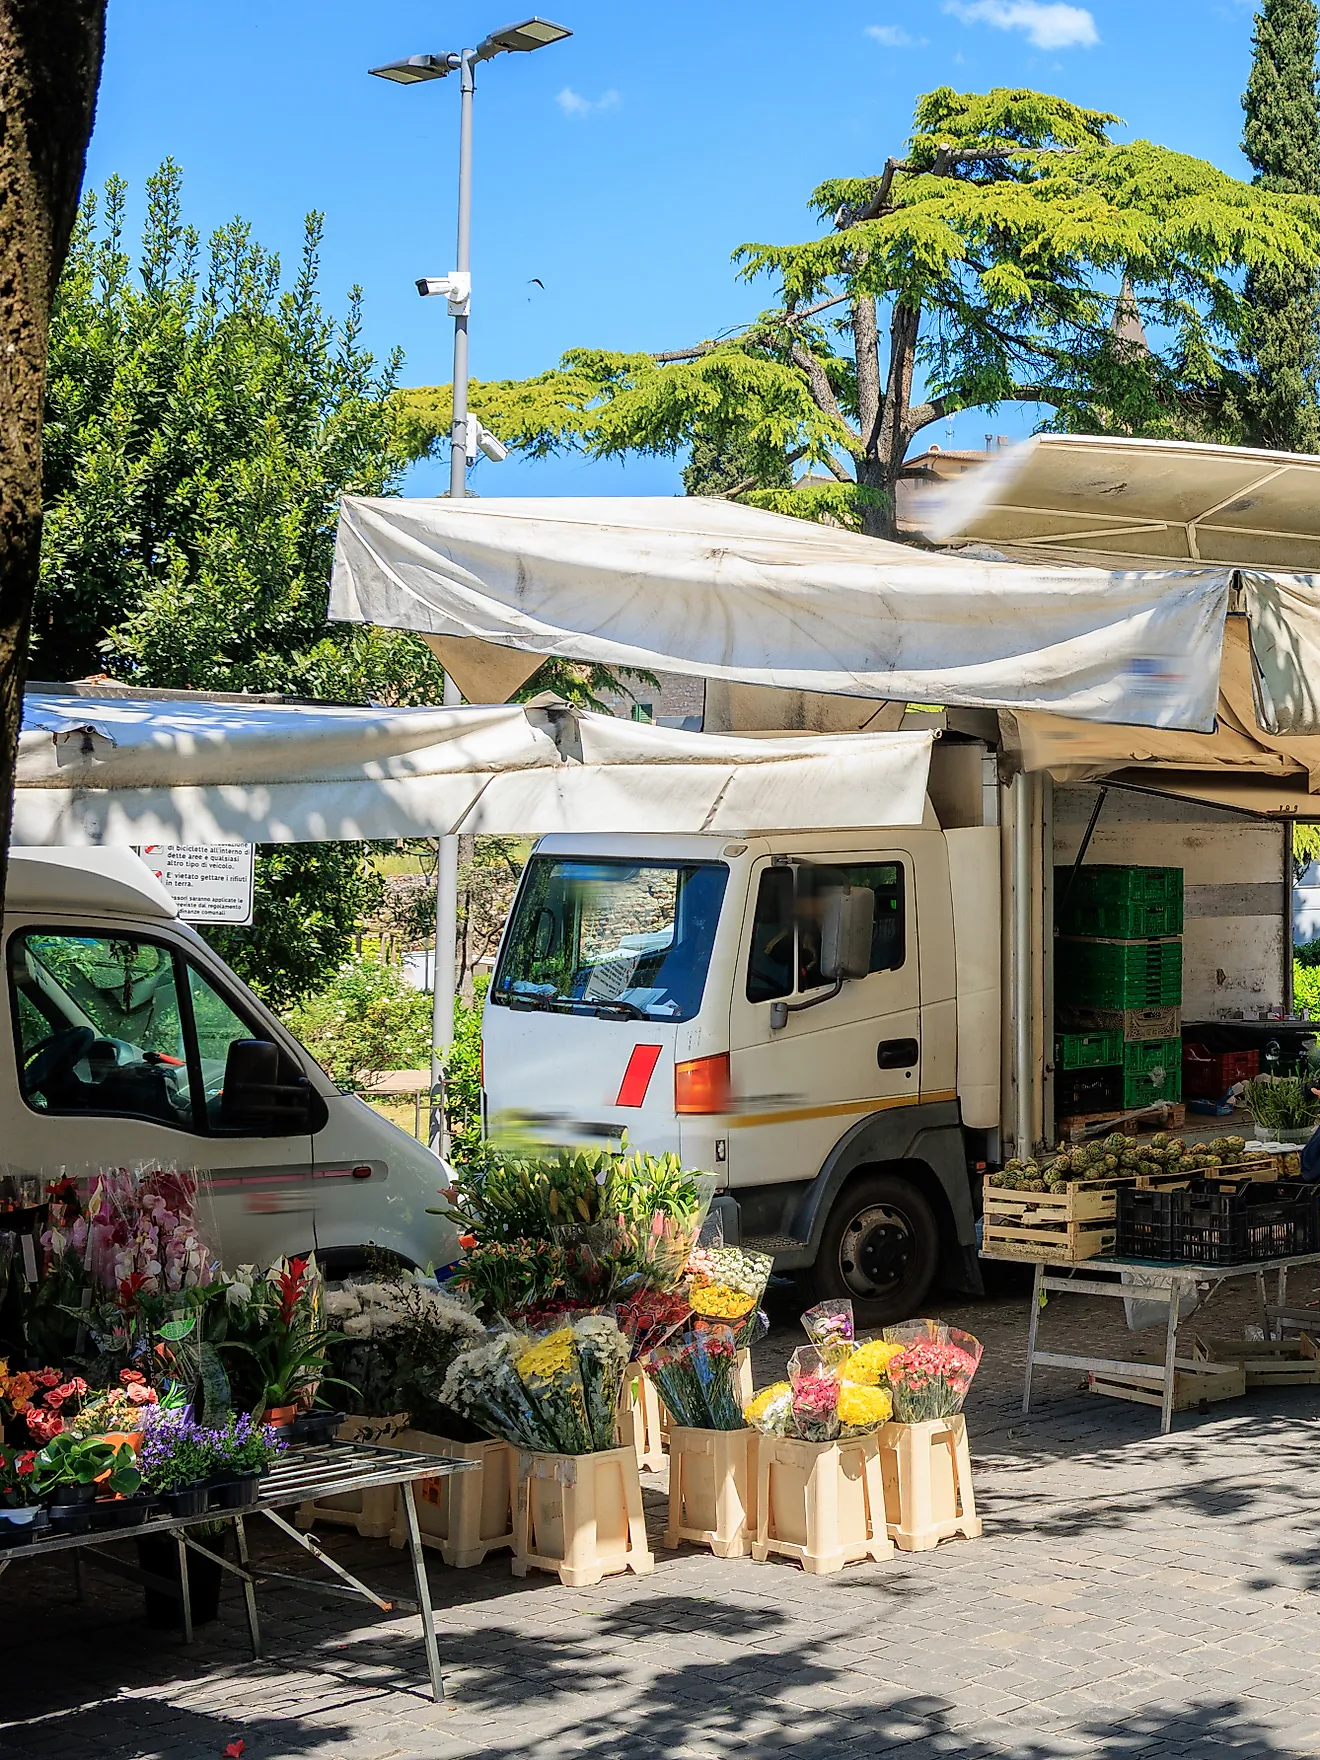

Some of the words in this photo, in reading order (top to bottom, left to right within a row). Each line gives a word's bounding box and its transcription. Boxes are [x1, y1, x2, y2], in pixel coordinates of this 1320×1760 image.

[176, 845, 208, 853] biciclette
[174, 872, 199, 880] vietato
[200, 874, 225, 882] gettare
